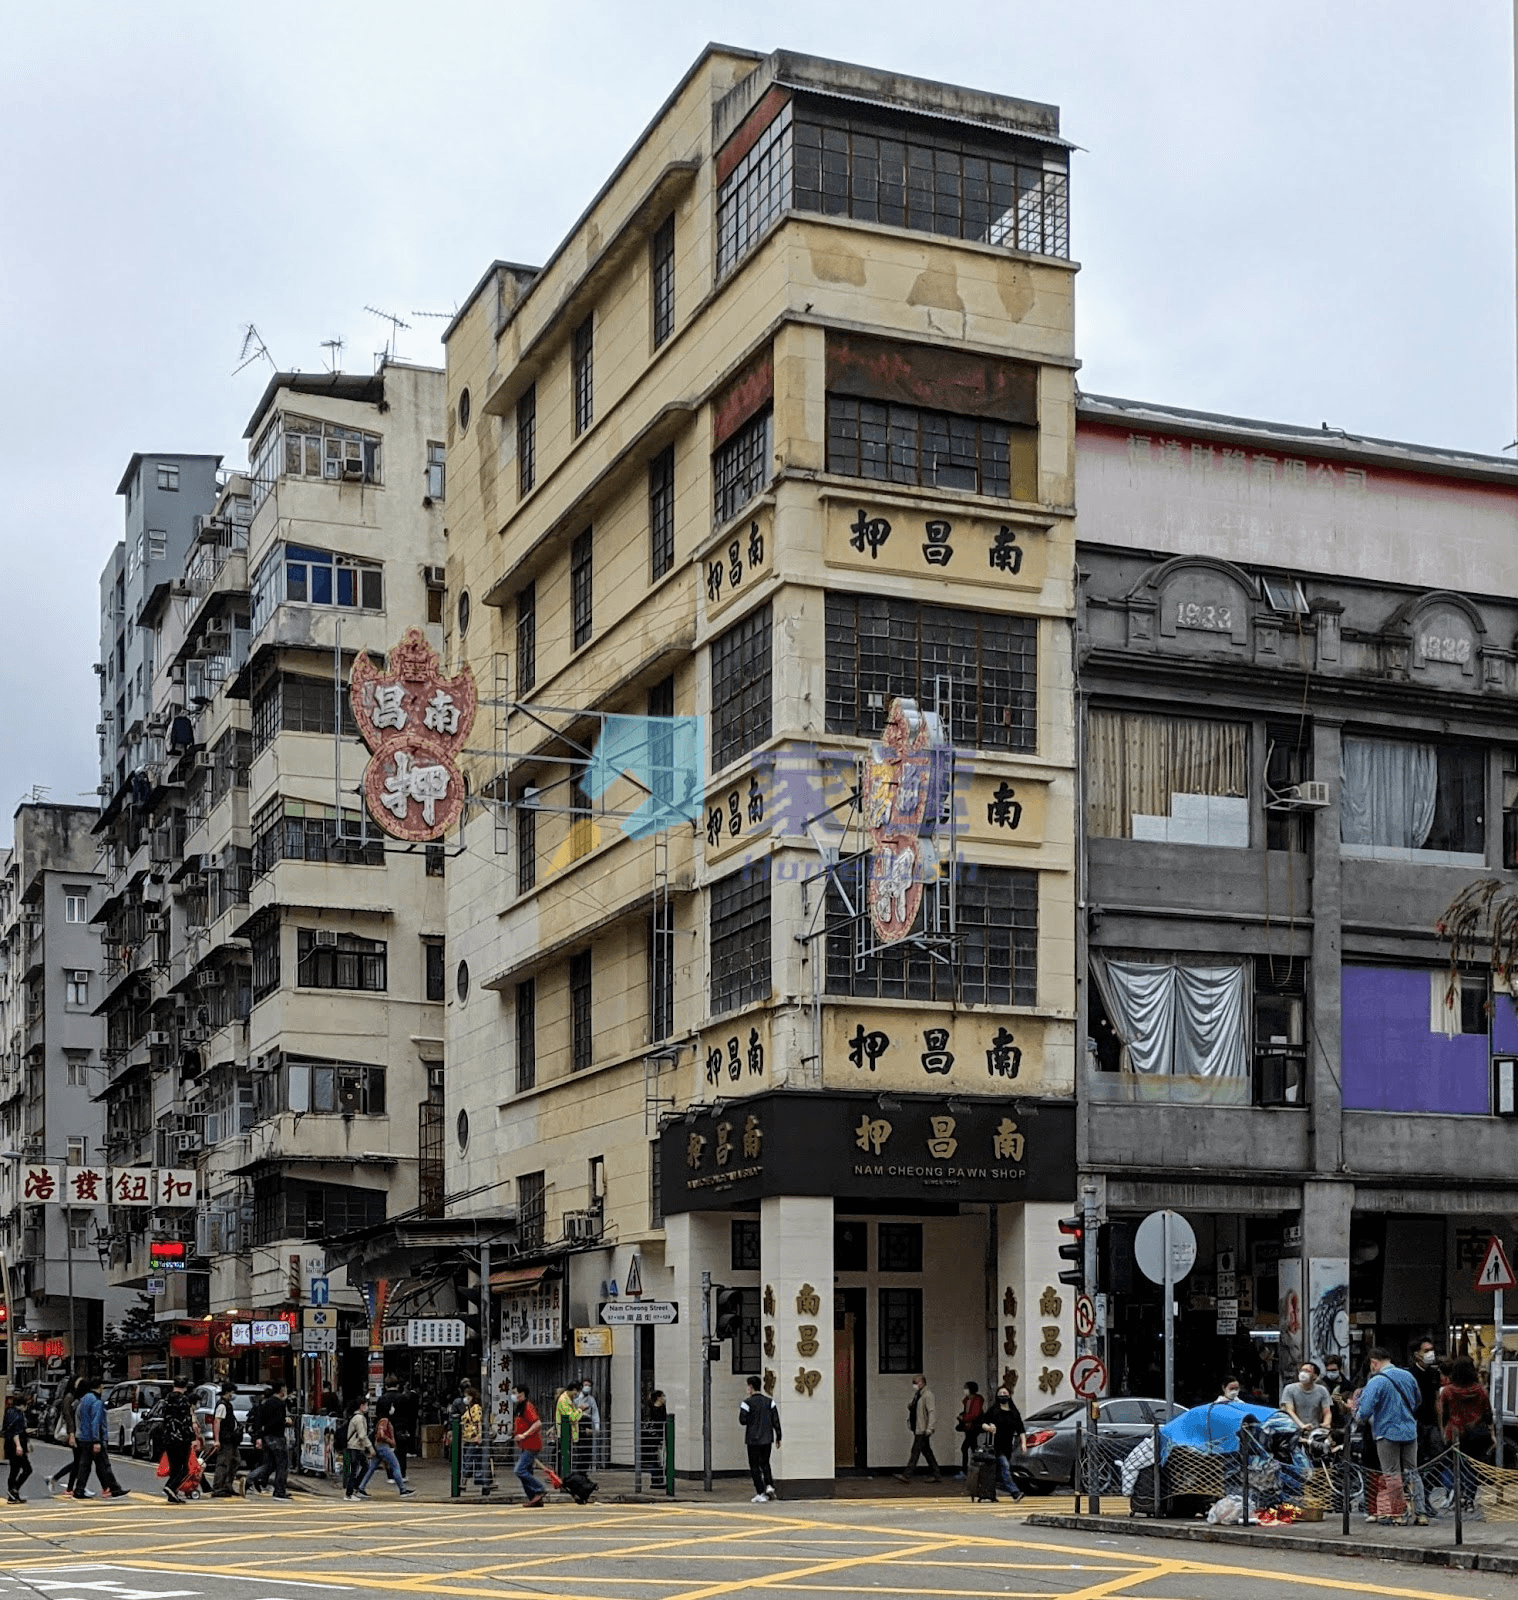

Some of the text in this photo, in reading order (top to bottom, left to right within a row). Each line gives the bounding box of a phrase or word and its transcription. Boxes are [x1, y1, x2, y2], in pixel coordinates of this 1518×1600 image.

[380, 751, 450, 826] 押
[854, 1165, 1027, 1179] NAM CHEONG PAWN SHOP
[324, 1329, 329, 1338] 7
[324, 1341, 334, 1350] 12
[794, 1283, 822, 1397] 南昌押
[1038, 1285, 1064, 1395] 南昌押
